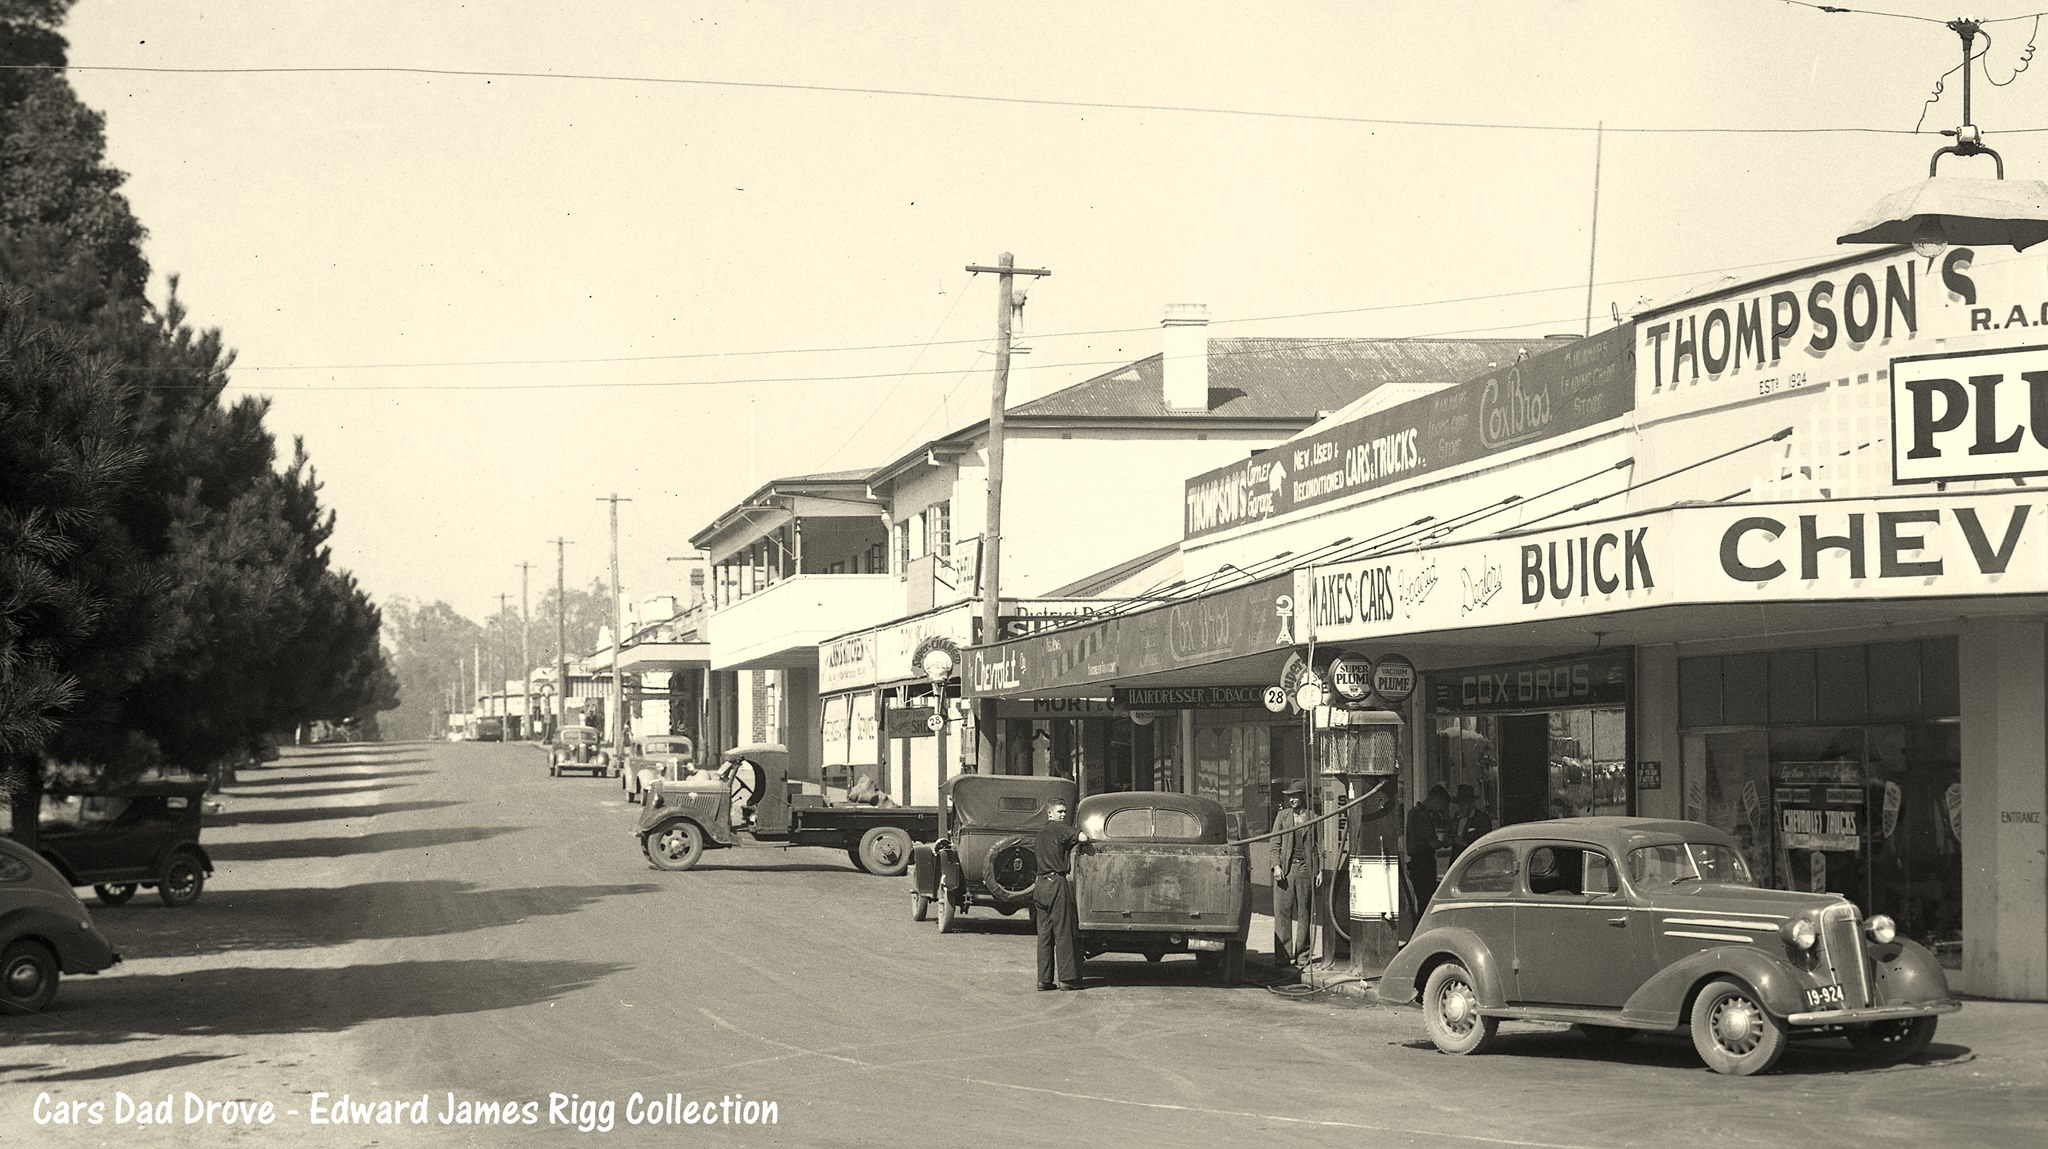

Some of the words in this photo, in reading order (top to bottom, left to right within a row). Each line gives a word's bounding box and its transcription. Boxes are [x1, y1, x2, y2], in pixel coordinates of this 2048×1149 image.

[1646, 247, 1977, 390] THOMPSON'S
[1788, 372, 1808, 389] 1924
[1313, 442, 1333, 465] USED
[1293, 469, 1344, 503] RECONDITIONED
[1345, 442, 1370, 486] CARS
[1521, 527, 1655, 604] BUICK
[1360, 565, 1394, 622] CARS
[1340, 665, 1369, 673] SUPER
[1381, 668, 1408, 676] VACUUM
[1336, 673, 1369, 685] PLUM
[1378, 677, 1410, 691] PLUME
[1129, 689, 1205, 704] HAIRDRESSER
[1268, 690, 1284, 704] 28
[1462, 673, 1509, 706] COX
[930, 716, 941, 726] 28
[1782, 809, 1823, 834] CHEVROLET
[1825, 810, 1857, 835] TRUCKS
[2001, 811, 2041, 824] ENTRANCE
[1807, 985, 1844, 1006] 19-924
